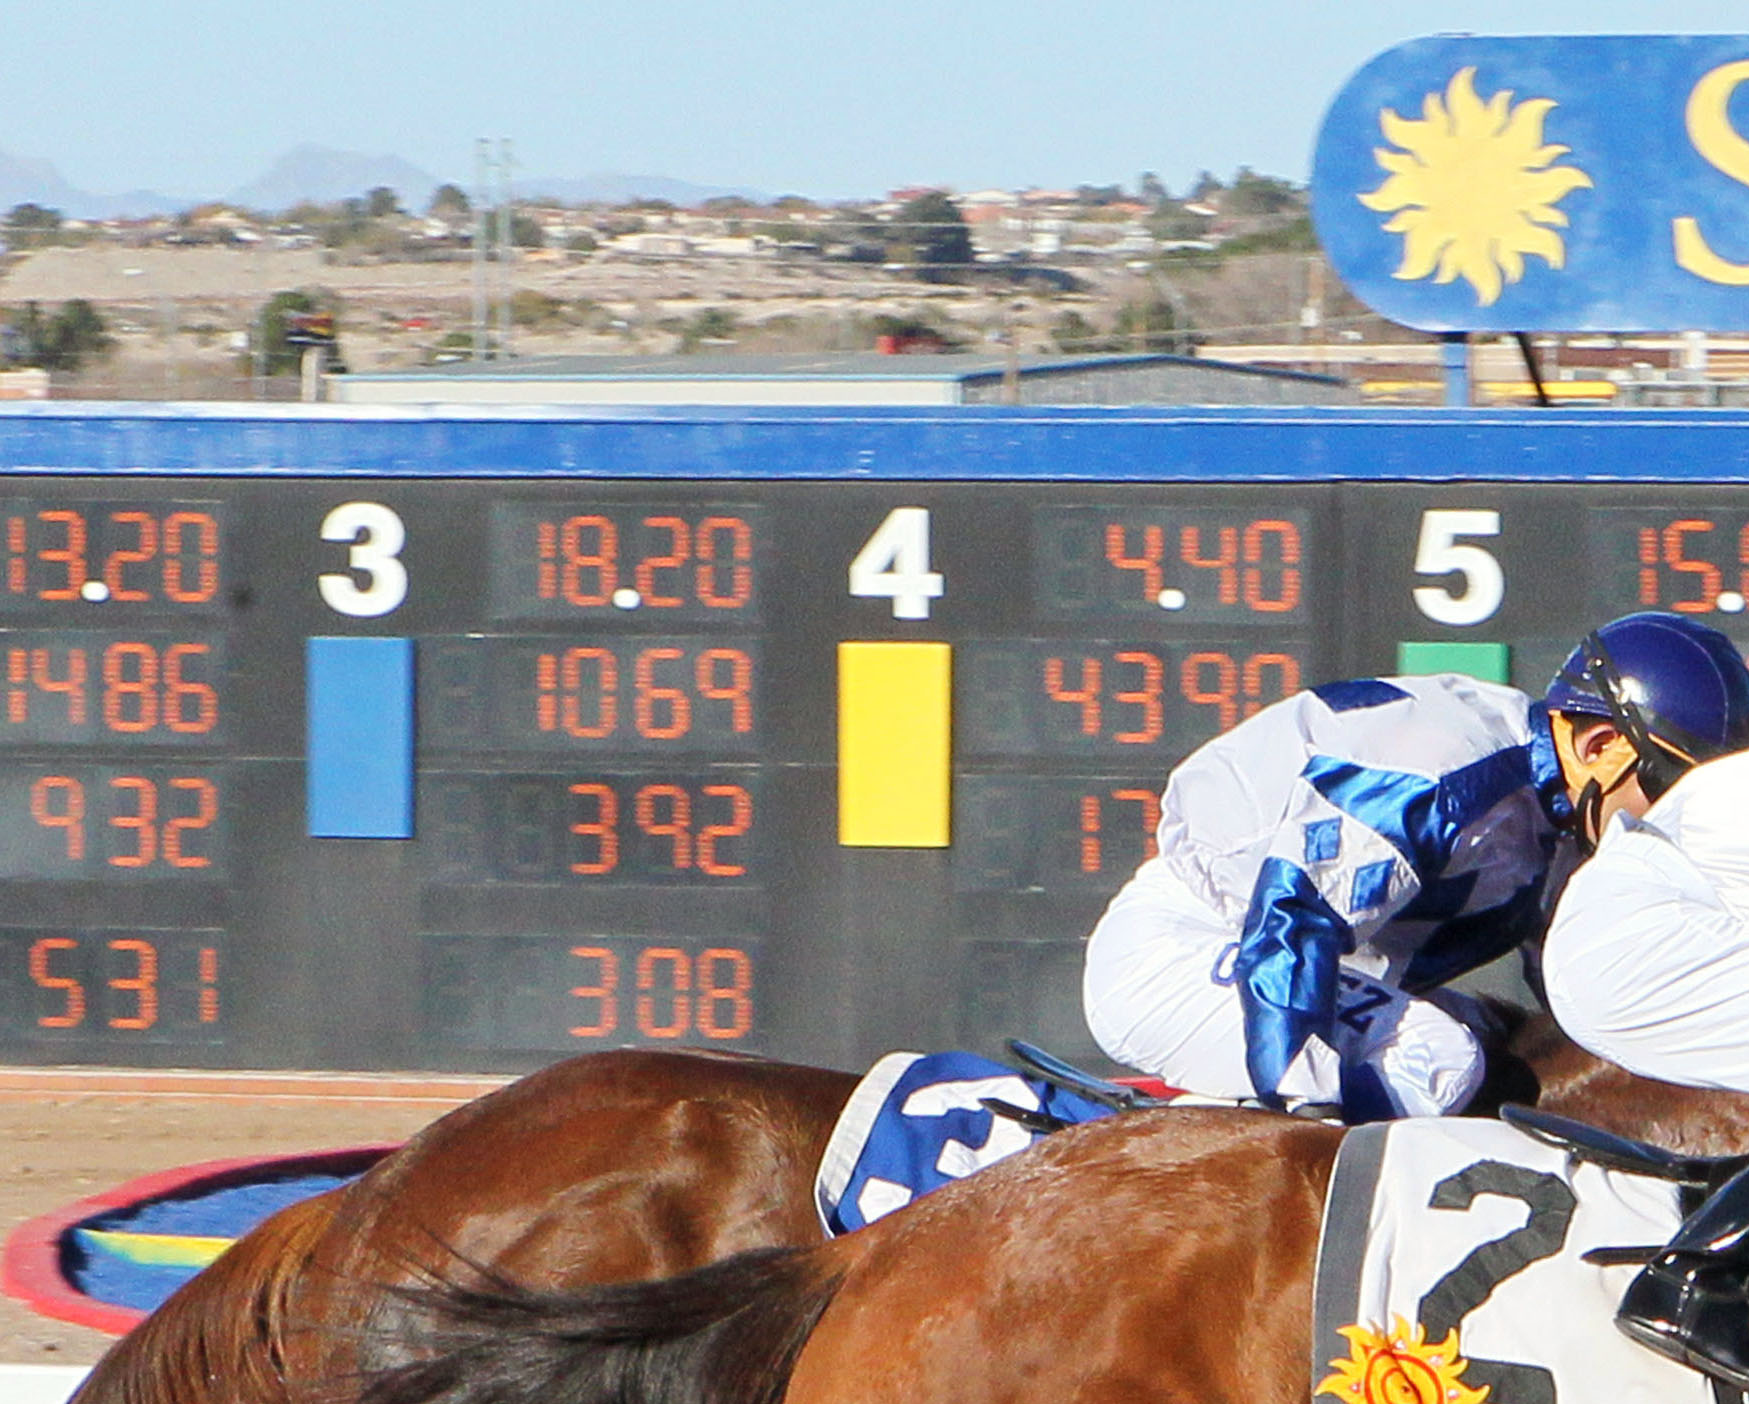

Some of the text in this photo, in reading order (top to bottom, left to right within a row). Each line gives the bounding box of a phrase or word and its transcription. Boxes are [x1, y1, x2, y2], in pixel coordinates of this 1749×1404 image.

[6, 509, 219, 604] 13.20
[318, 501, 408, 617] 3
[537, 514, 753, 611] 18.20
[848, 507, 945, 619] 4
[1105, 518, 1301, 613] 4.40
[1412, 510, 1504, 626] 5
[6, 641, 219, 734] 1486
[537, 647, 753, 740] 1069
[30, 775, 219, 868] 932
[567, 783, 754, 877] 392
[28, 937, 219, 1031] 531
[570, 946, 754, 1040] 308
